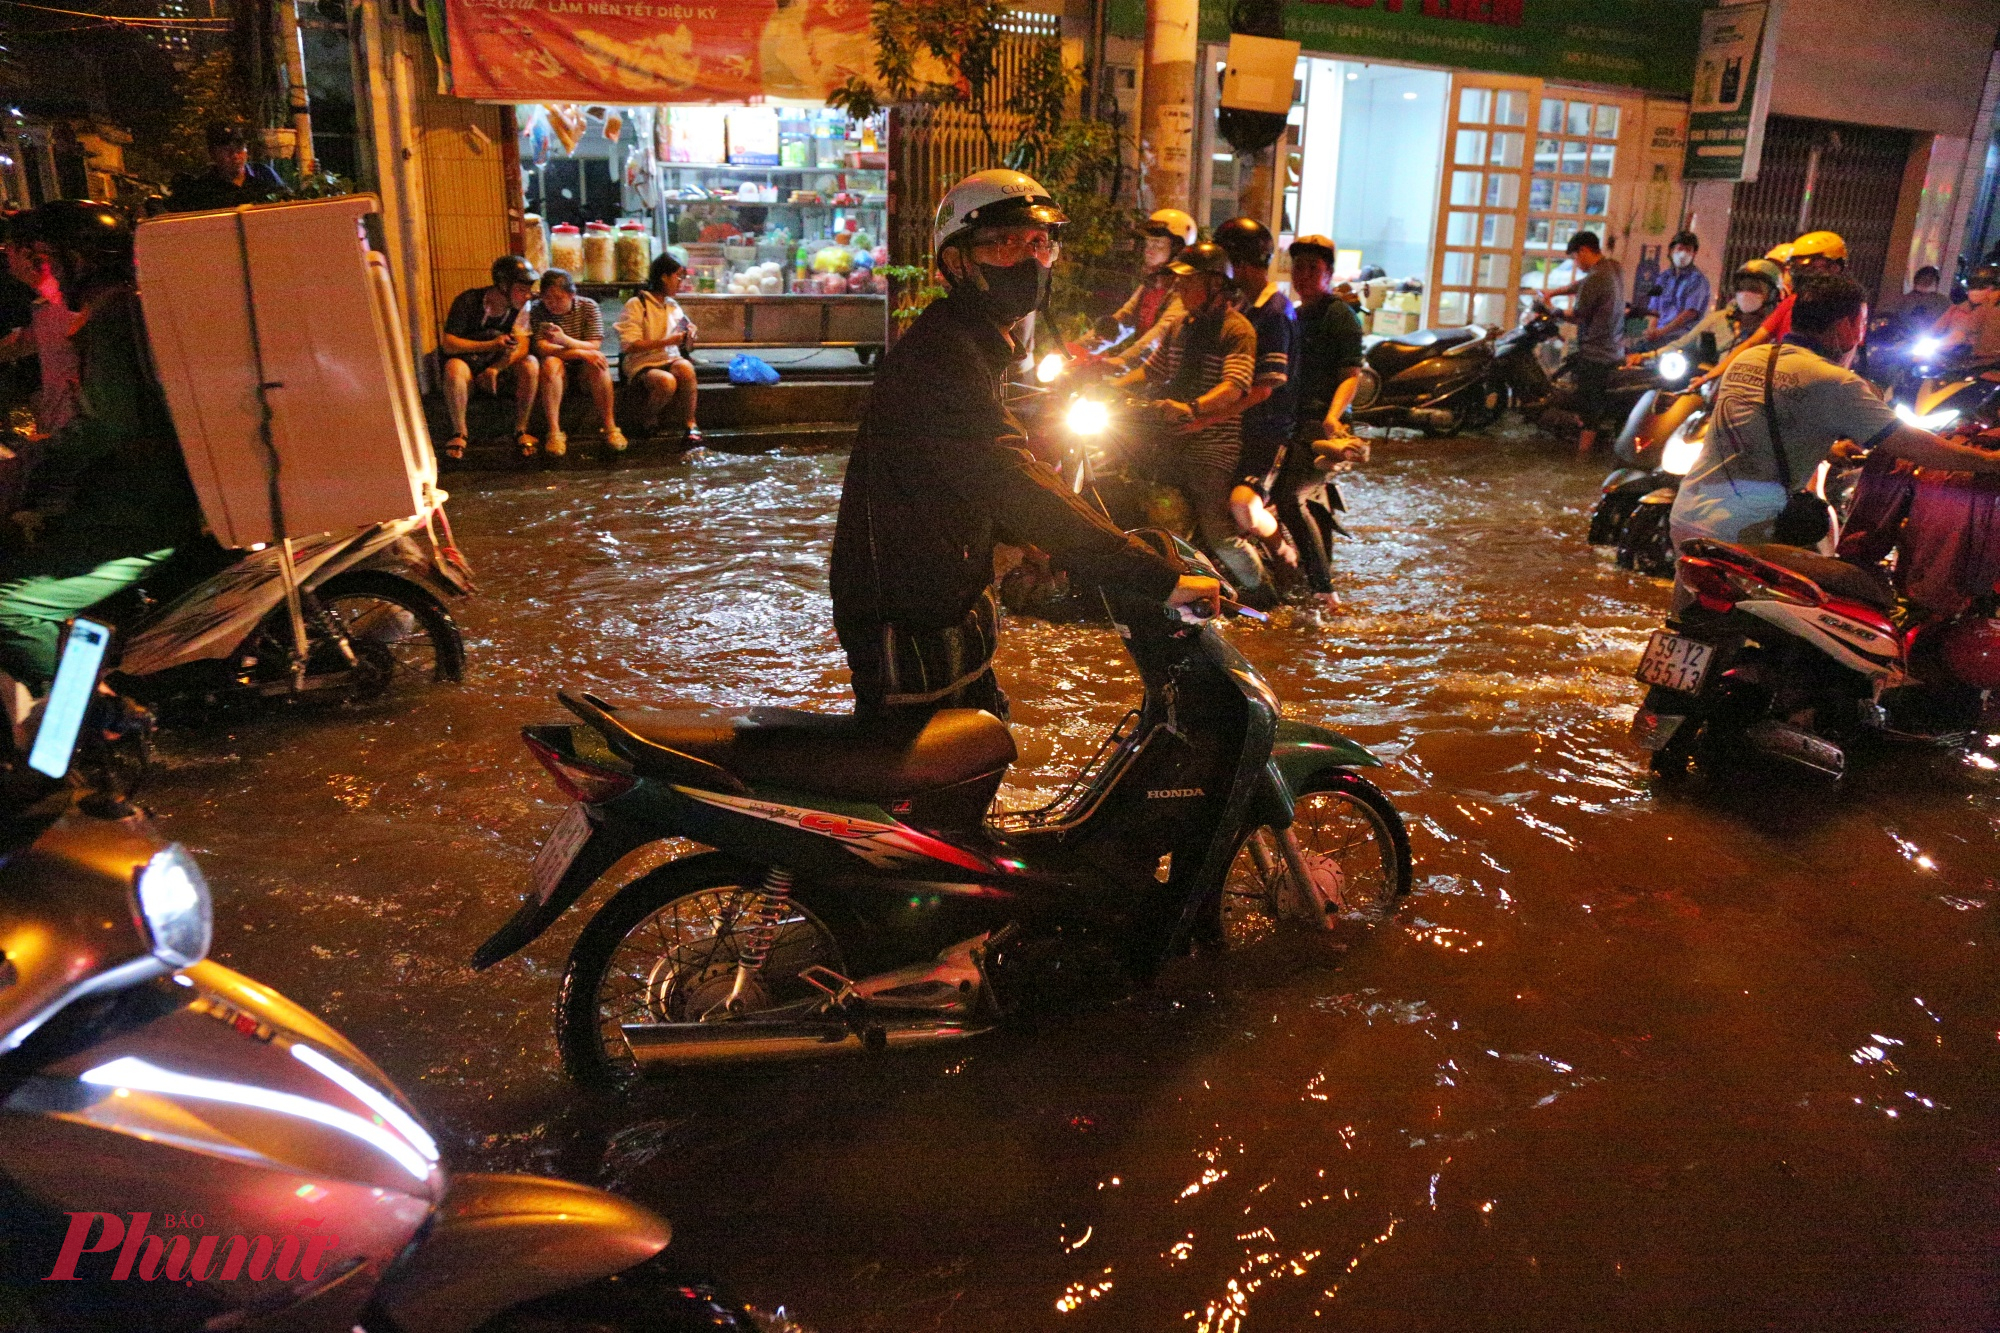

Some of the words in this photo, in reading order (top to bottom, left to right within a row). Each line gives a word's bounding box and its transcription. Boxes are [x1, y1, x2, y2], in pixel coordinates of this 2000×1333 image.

[588, 2, 621, 15] NÊN
[624, 3, 651, 17] TẾT
[657, 4, 693, 20] DIỆU
[1146, 788, 1205, 799] HONDA
